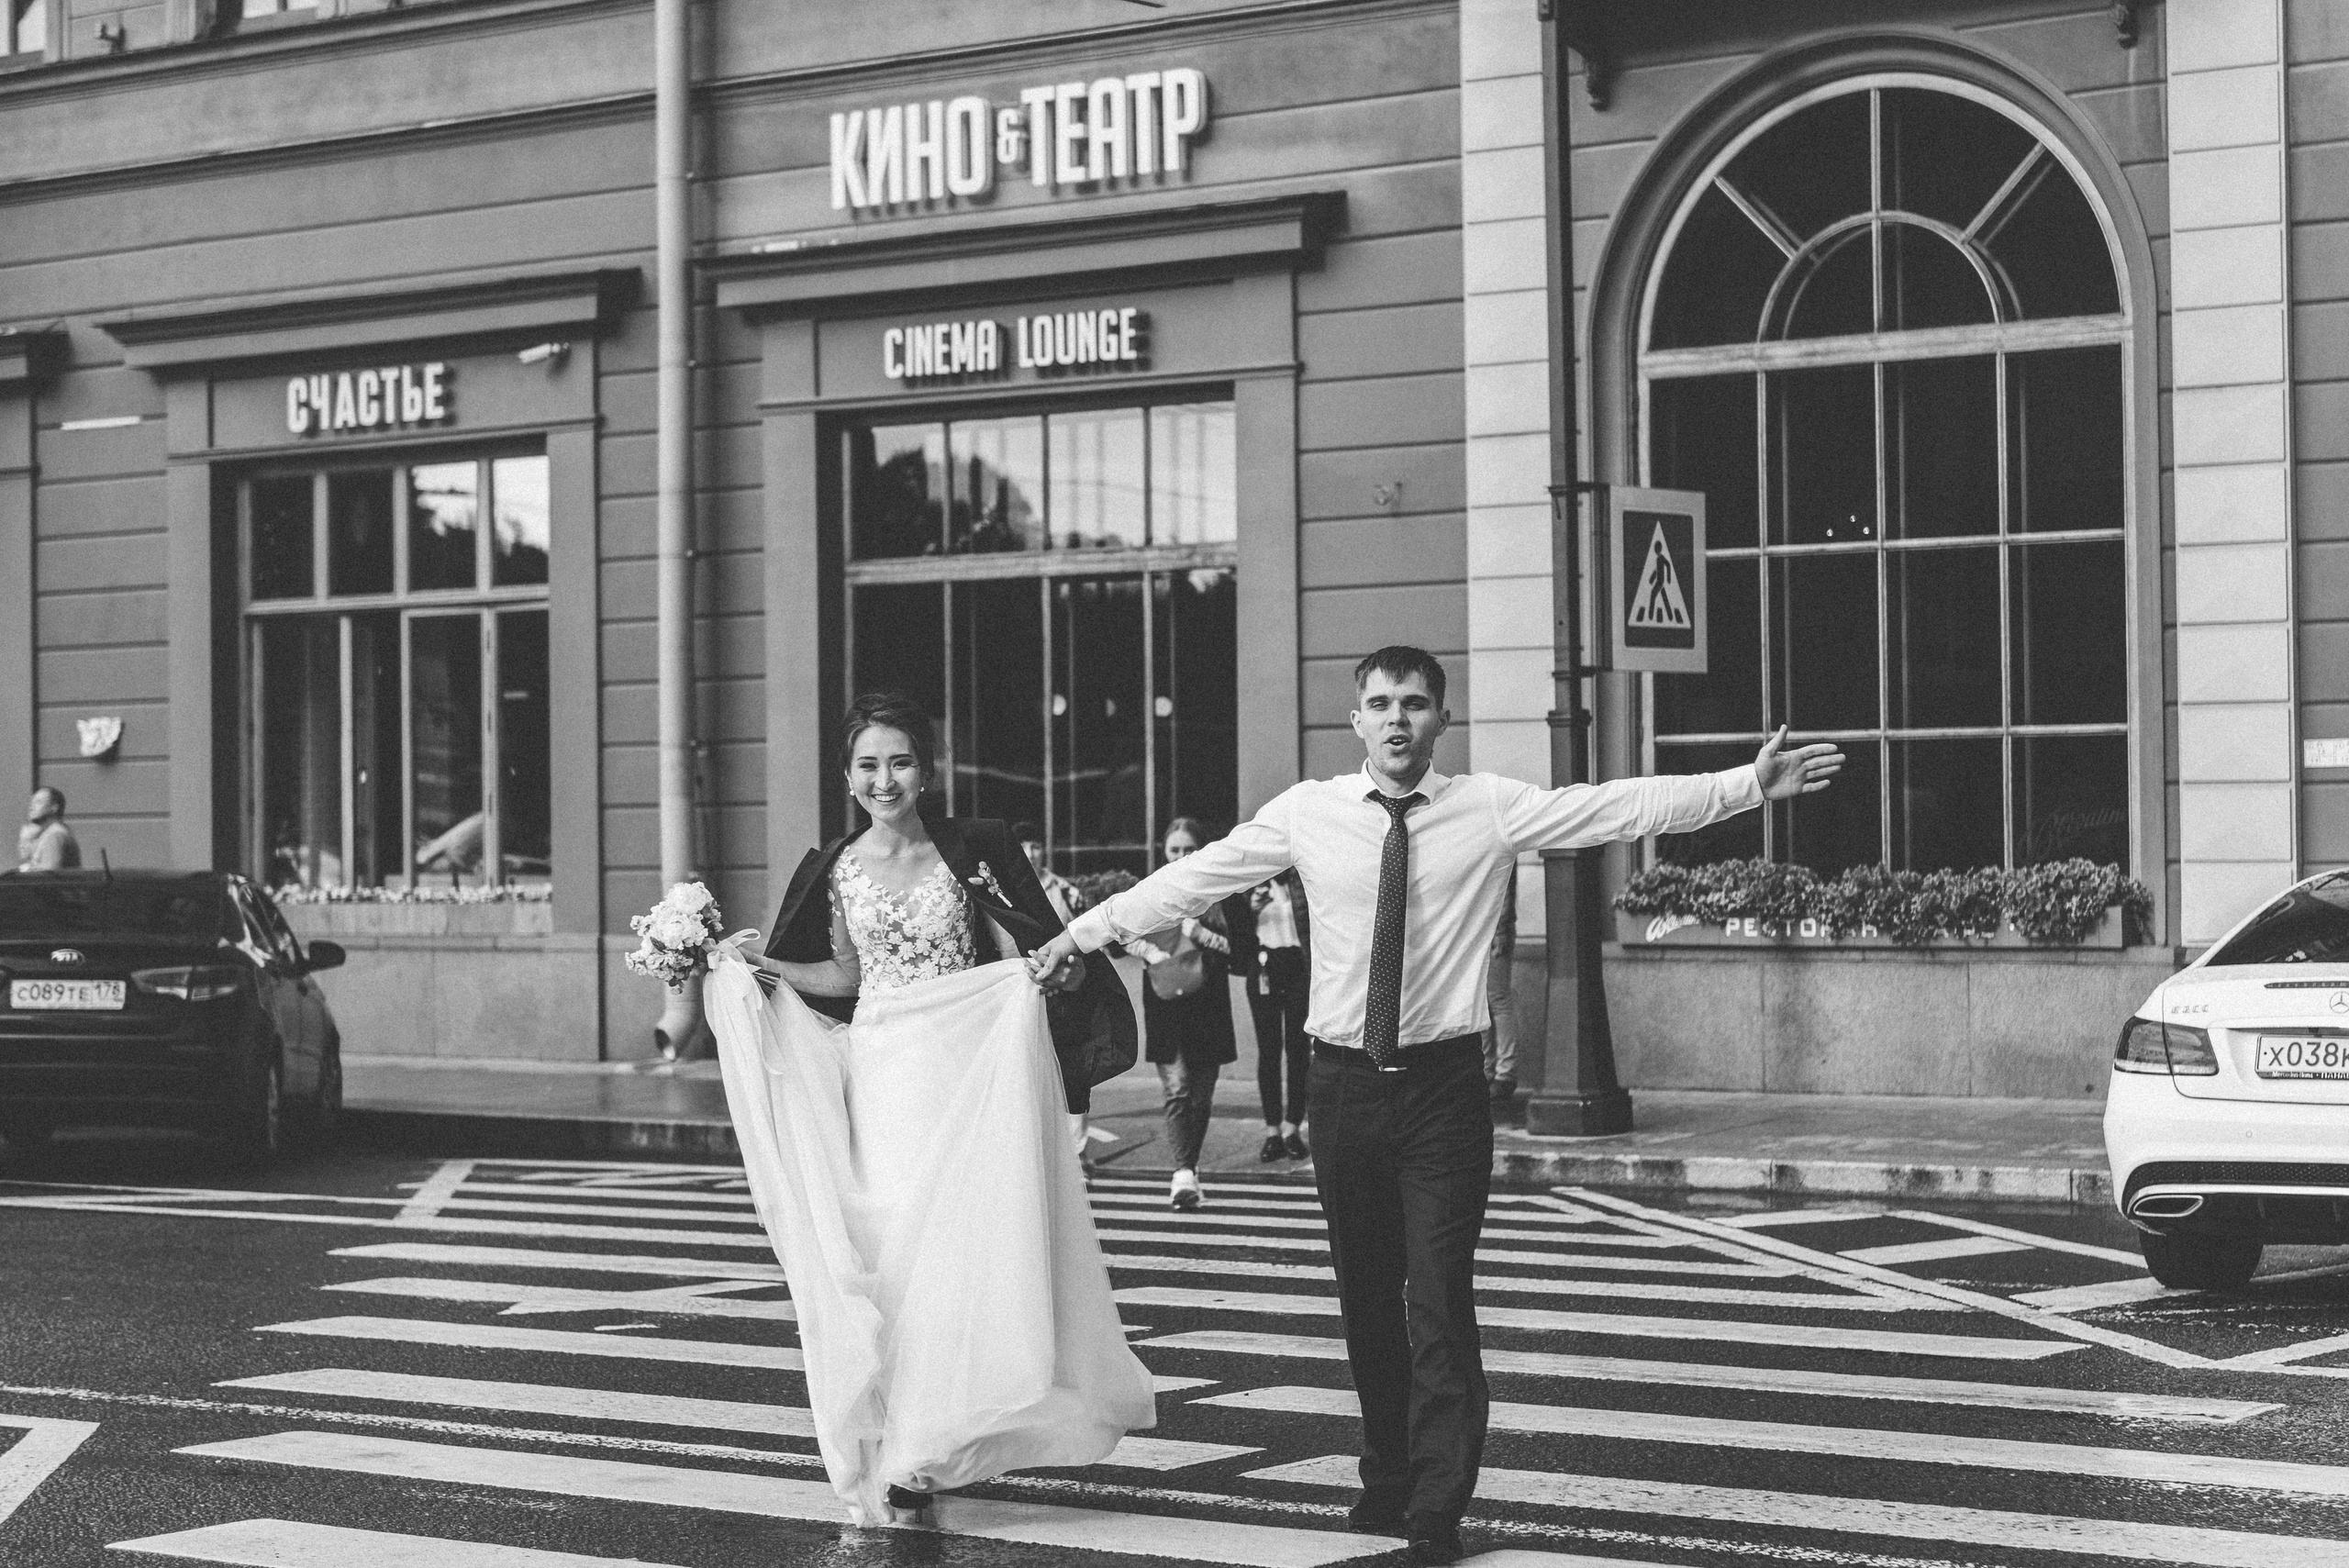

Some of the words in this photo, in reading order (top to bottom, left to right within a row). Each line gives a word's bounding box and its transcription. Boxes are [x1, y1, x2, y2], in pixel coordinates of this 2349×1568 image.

[884, 319, 998, 380] CINEMA
[1017, 307, 1138, 368] LOUNGE
[287, 361, 446, 434] СЧАСТЬЕ
